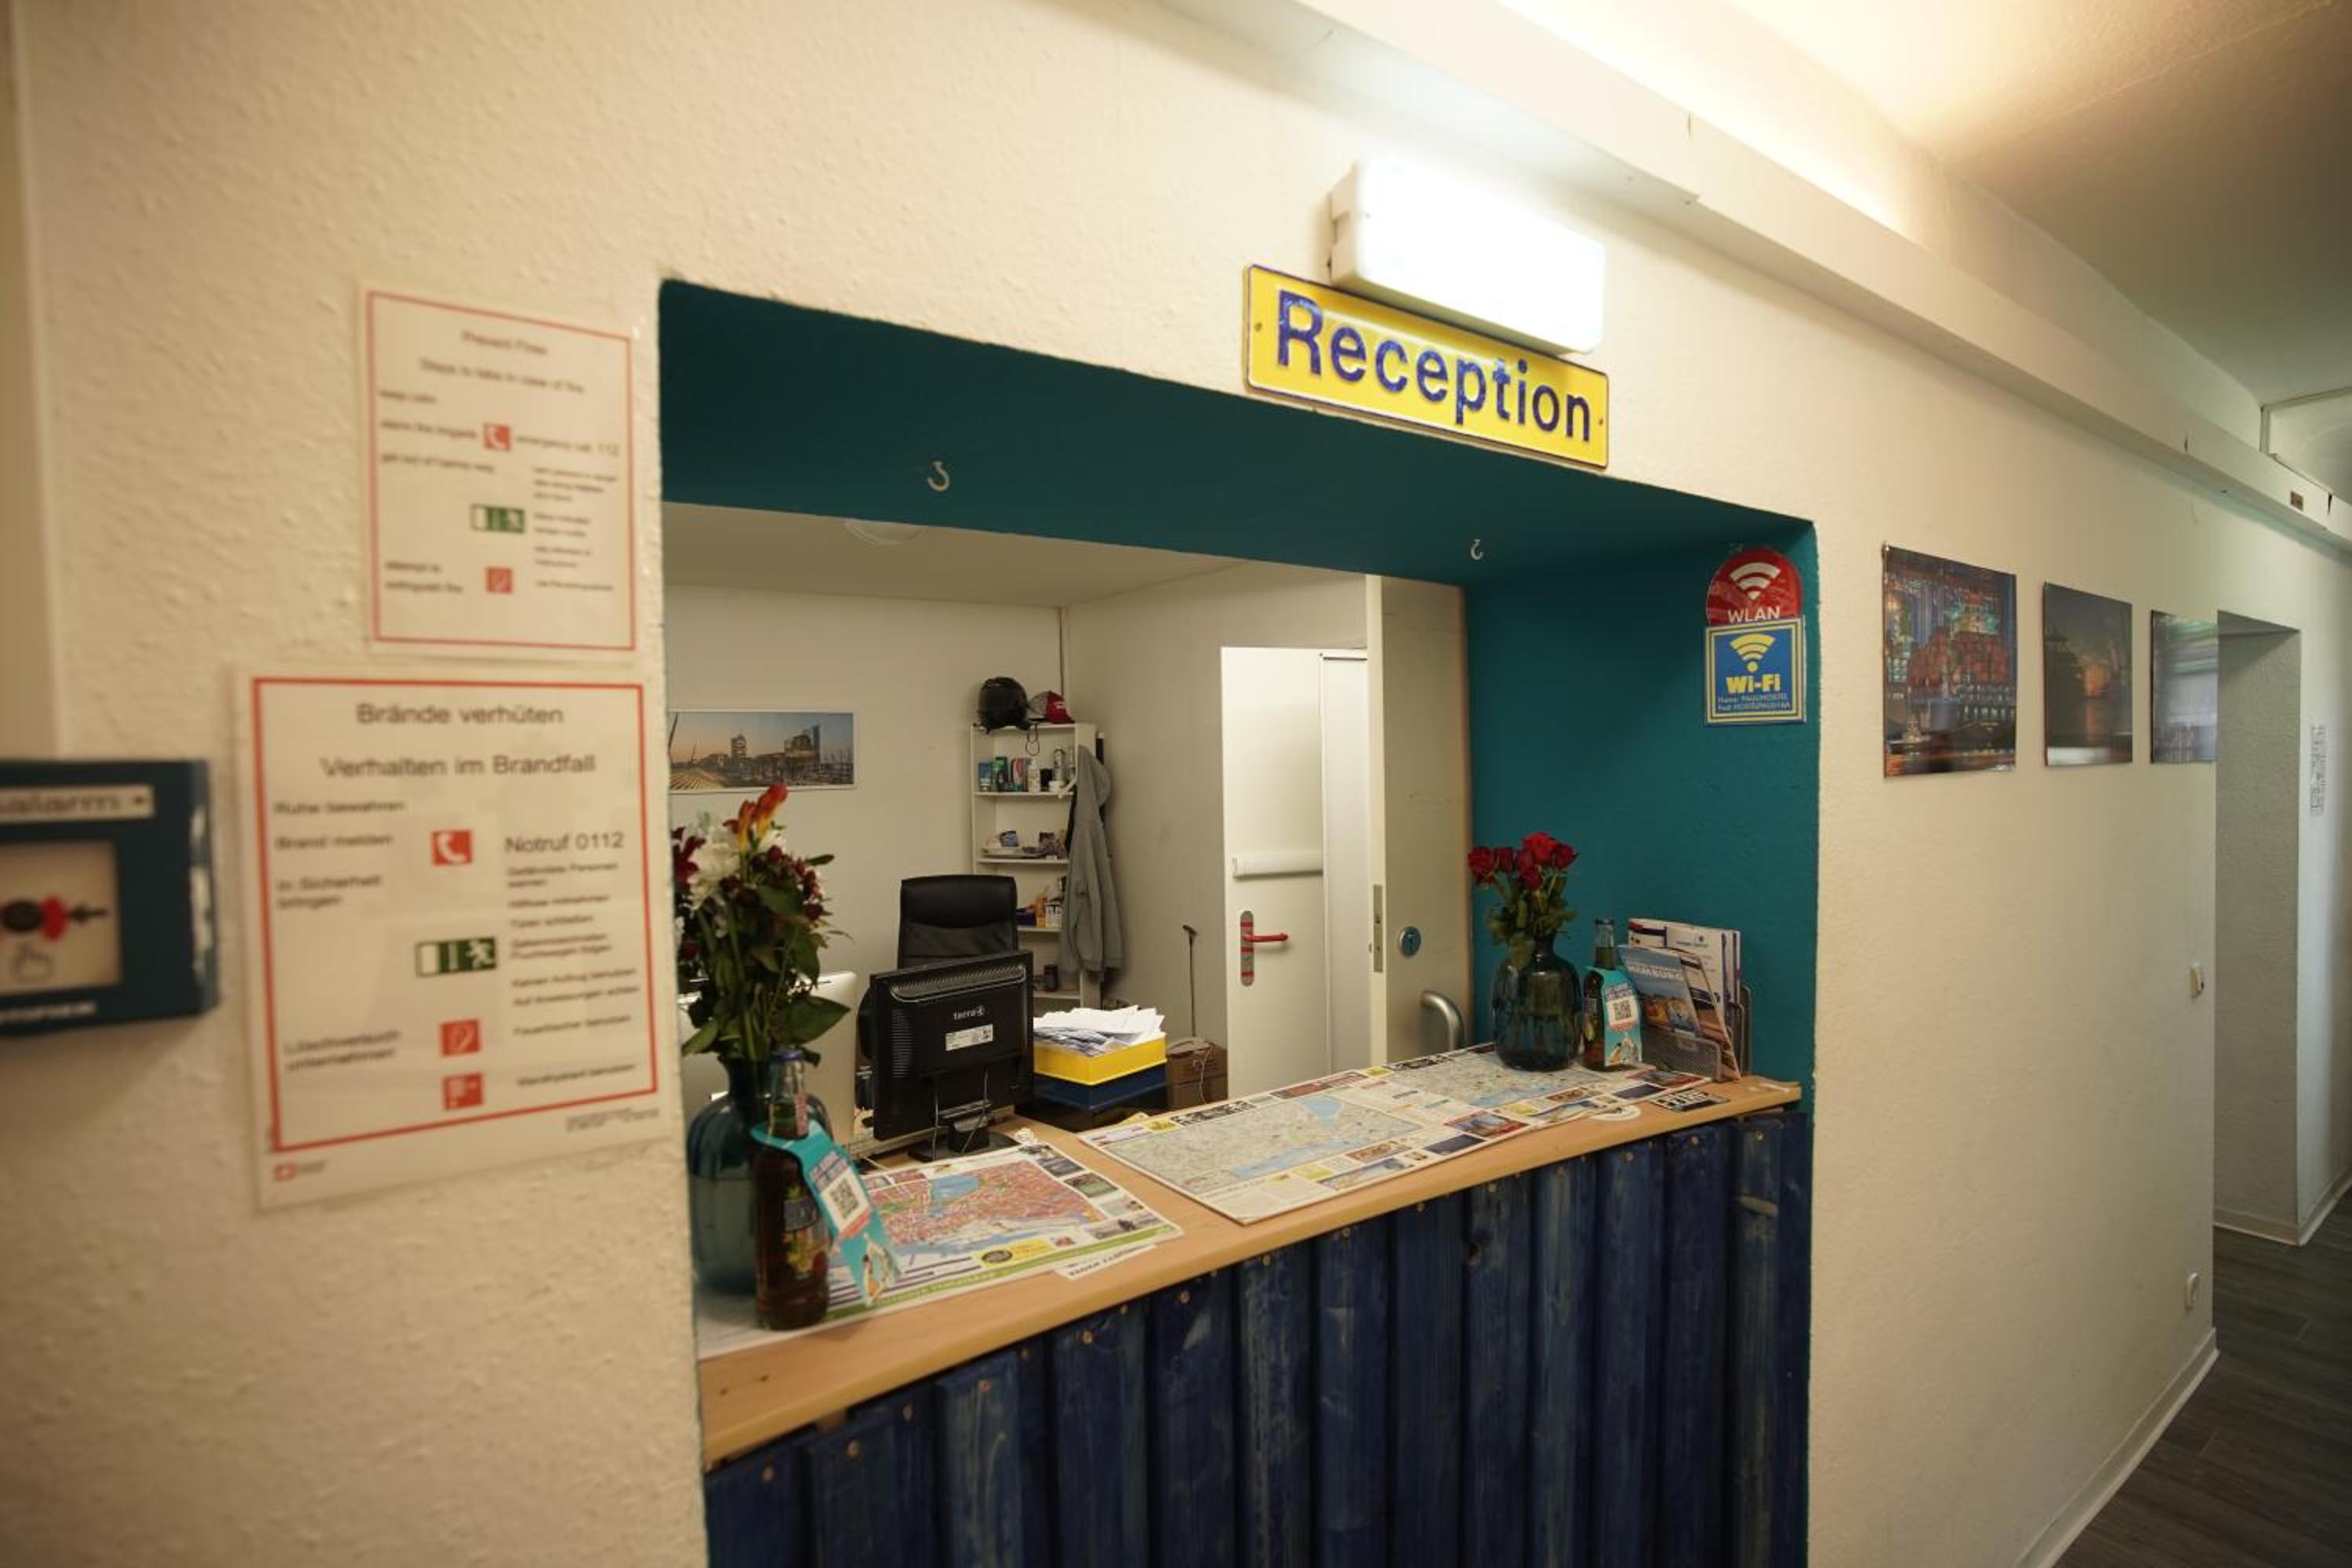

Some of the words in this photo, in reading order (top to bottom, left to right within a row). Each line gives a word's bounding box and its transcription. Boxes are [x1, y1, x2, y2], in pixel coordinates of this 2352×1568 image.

[1276, 289, 1592, 442] Reception
[1727, 606, 1781, 623] WLAN
[1726, 673, 1780, 694] Wi-Fi
[355, 702, 452, 724] Brände
[458, 702, 565, 724] verhüten
[318, 755, 448, 778] Verhalten
[455, 754, 485, 775] im
[492, 753, 596, 775] Brandfall
[504, 833, 570, 853] Notruf
[574, 830, 625, 851] 0112
